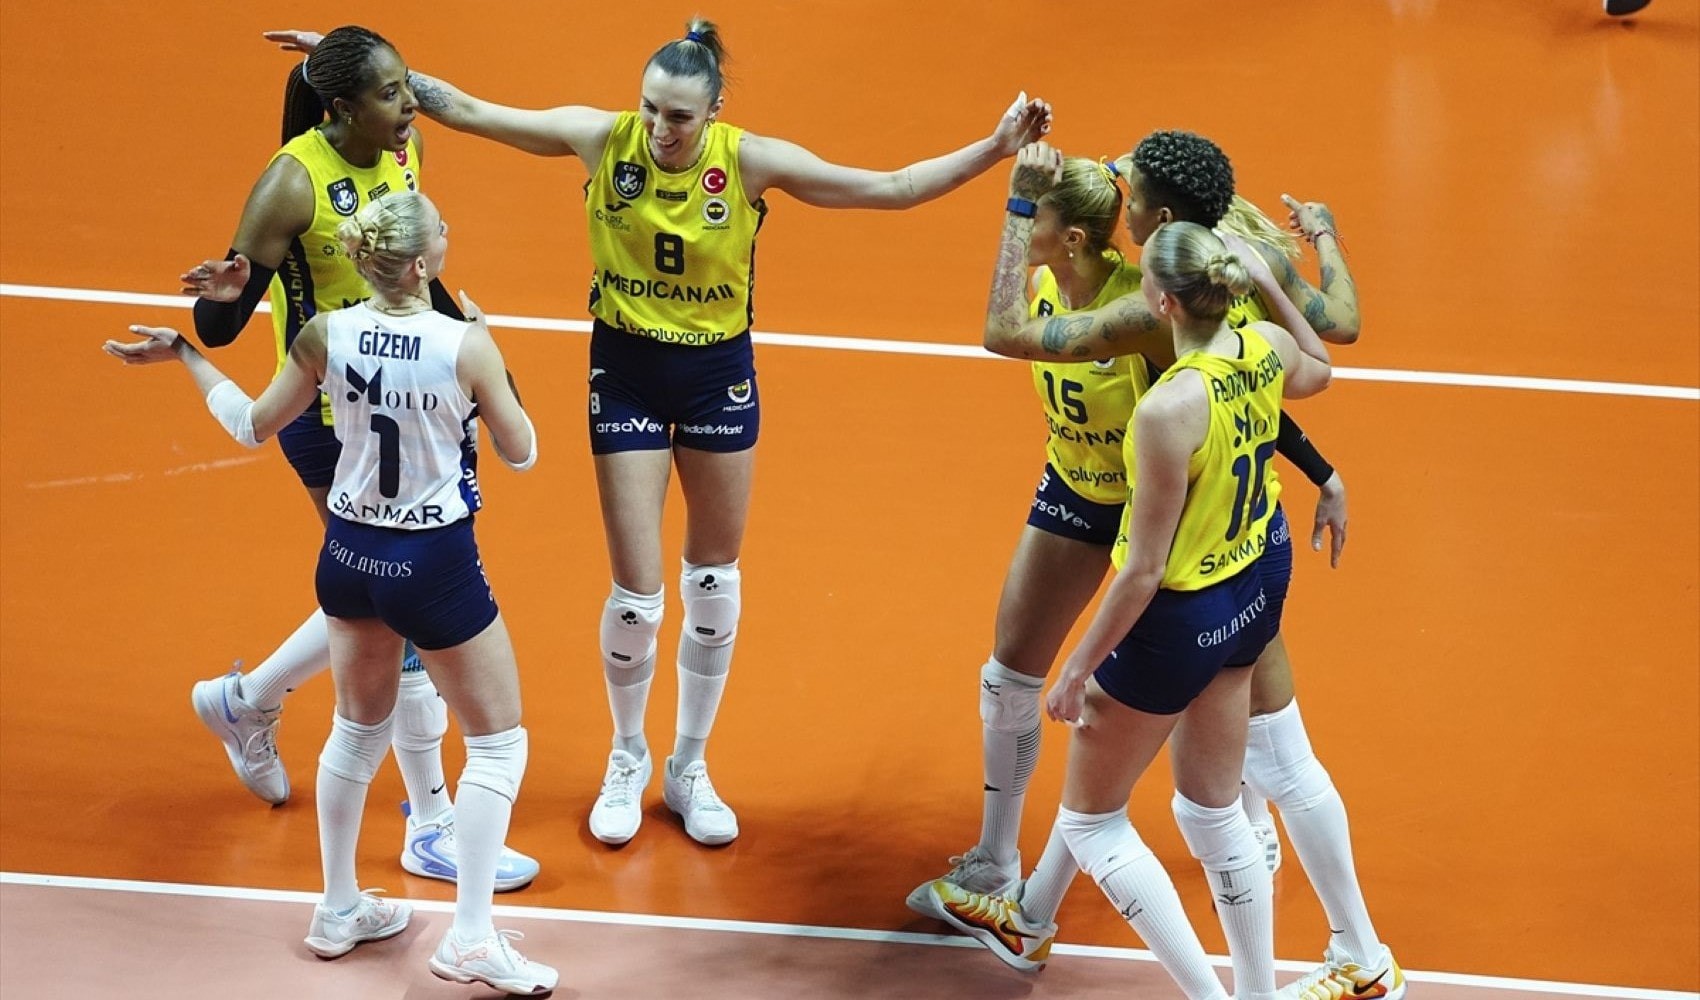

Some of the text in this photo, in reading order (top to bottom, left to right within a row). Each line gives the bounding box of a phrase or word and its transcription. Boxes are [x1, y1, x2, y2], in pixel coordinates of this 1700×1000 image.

[623, 164, 639, 173] CEV
[654, 232, 685, 275] 8
[358, 326, 421, 362] GİZEM
[1043, 370, 1089, 425] 15
[370, 412, 400, 499] 1
[333, 492, 444, 525] SANMAR
[328, 539, 413, 578] GALAKTOS
[1199, 534, 1266, 575] SANMA
